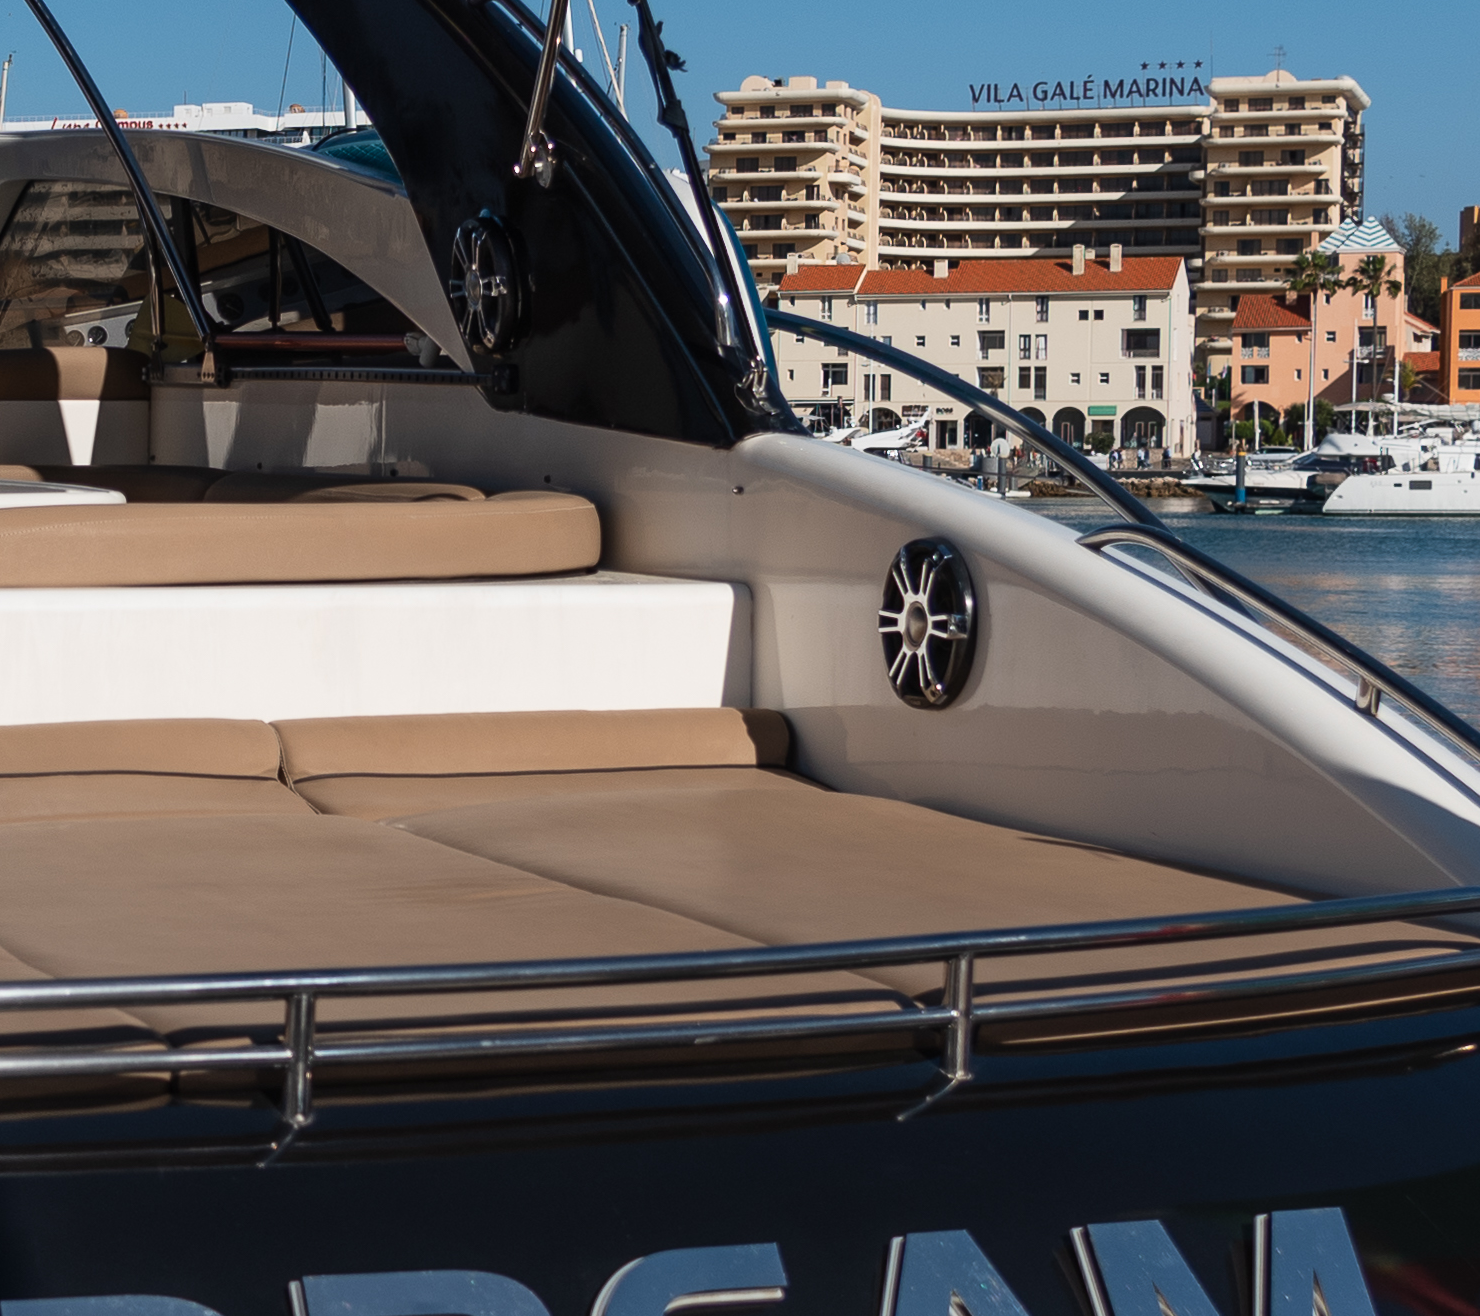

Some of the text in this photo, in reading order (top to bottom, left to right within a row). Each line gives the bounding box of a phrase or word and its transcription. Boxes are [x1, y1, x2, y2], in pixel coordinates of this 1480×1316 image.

[969, 74, 1205, 104] VILA GALÉ MARINA
[95, 119, 154, 130] Ompus
